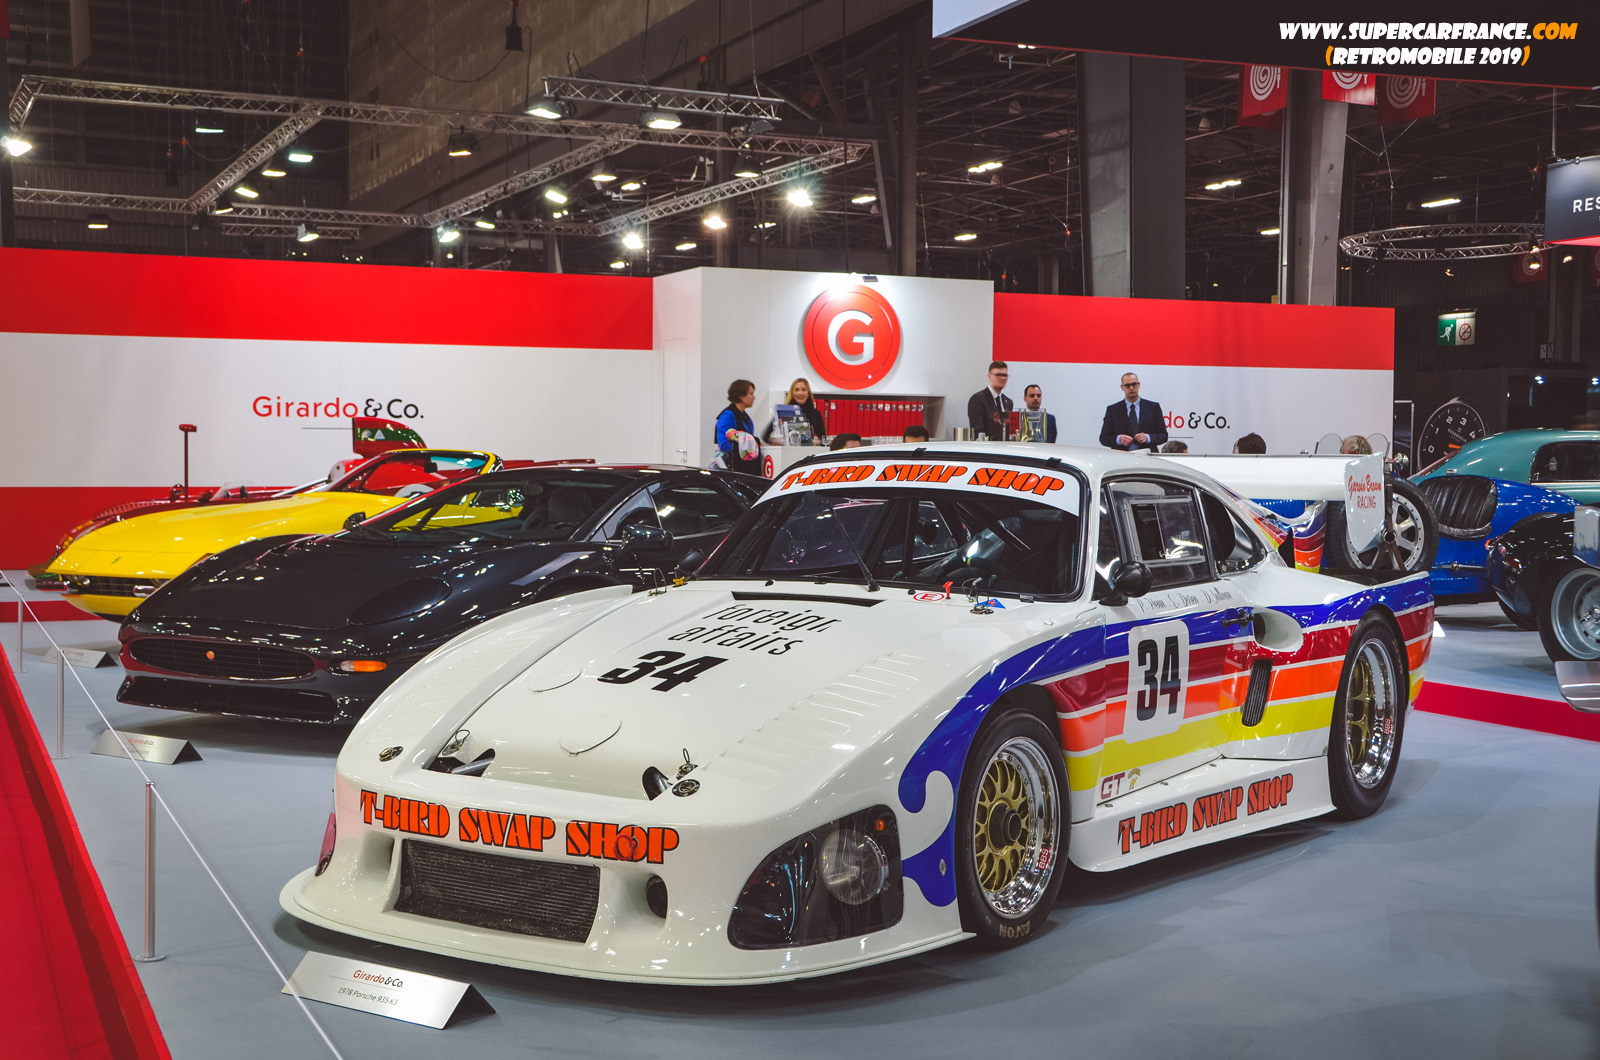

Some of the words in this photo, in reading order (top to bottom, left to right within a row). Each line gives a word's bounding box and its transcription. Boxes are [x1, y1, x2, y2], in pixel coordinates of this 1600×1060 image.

[828, 310, 874, 366] G
[1460, 418, 1467, 426] 3
[780, 464, 876, 490] T-BIRD
[876, 464, 968, 484] SWAP
[968, 468, 1064, 496] SHOP
[1357, 496, 1376, 509] RACING
[702, 604, 842, 632] foreign
[668, 625, 804, 655] affairs
[597, 650, 729, 692] 34
[1136, 636, 1181, 722] 34
[1101, 772, 1125, 800] GT
[360, 789, 450, 838] T-BIRD
[458, 807, 556, 852] SWAP
[565, 820, 680, 864] SHOP
[1118, 802, 1187, 854] T-BIRD
[1192, 786, 1243, 832] SWAP
[1248, 773, 1293, 815] SHOP
[1039, 848, 1049, 868] BBS
[999, 920, 1031, 939] AVON
[338, 987, 353, 996] 1978
[352, 990, 377, 1001] Porsche
